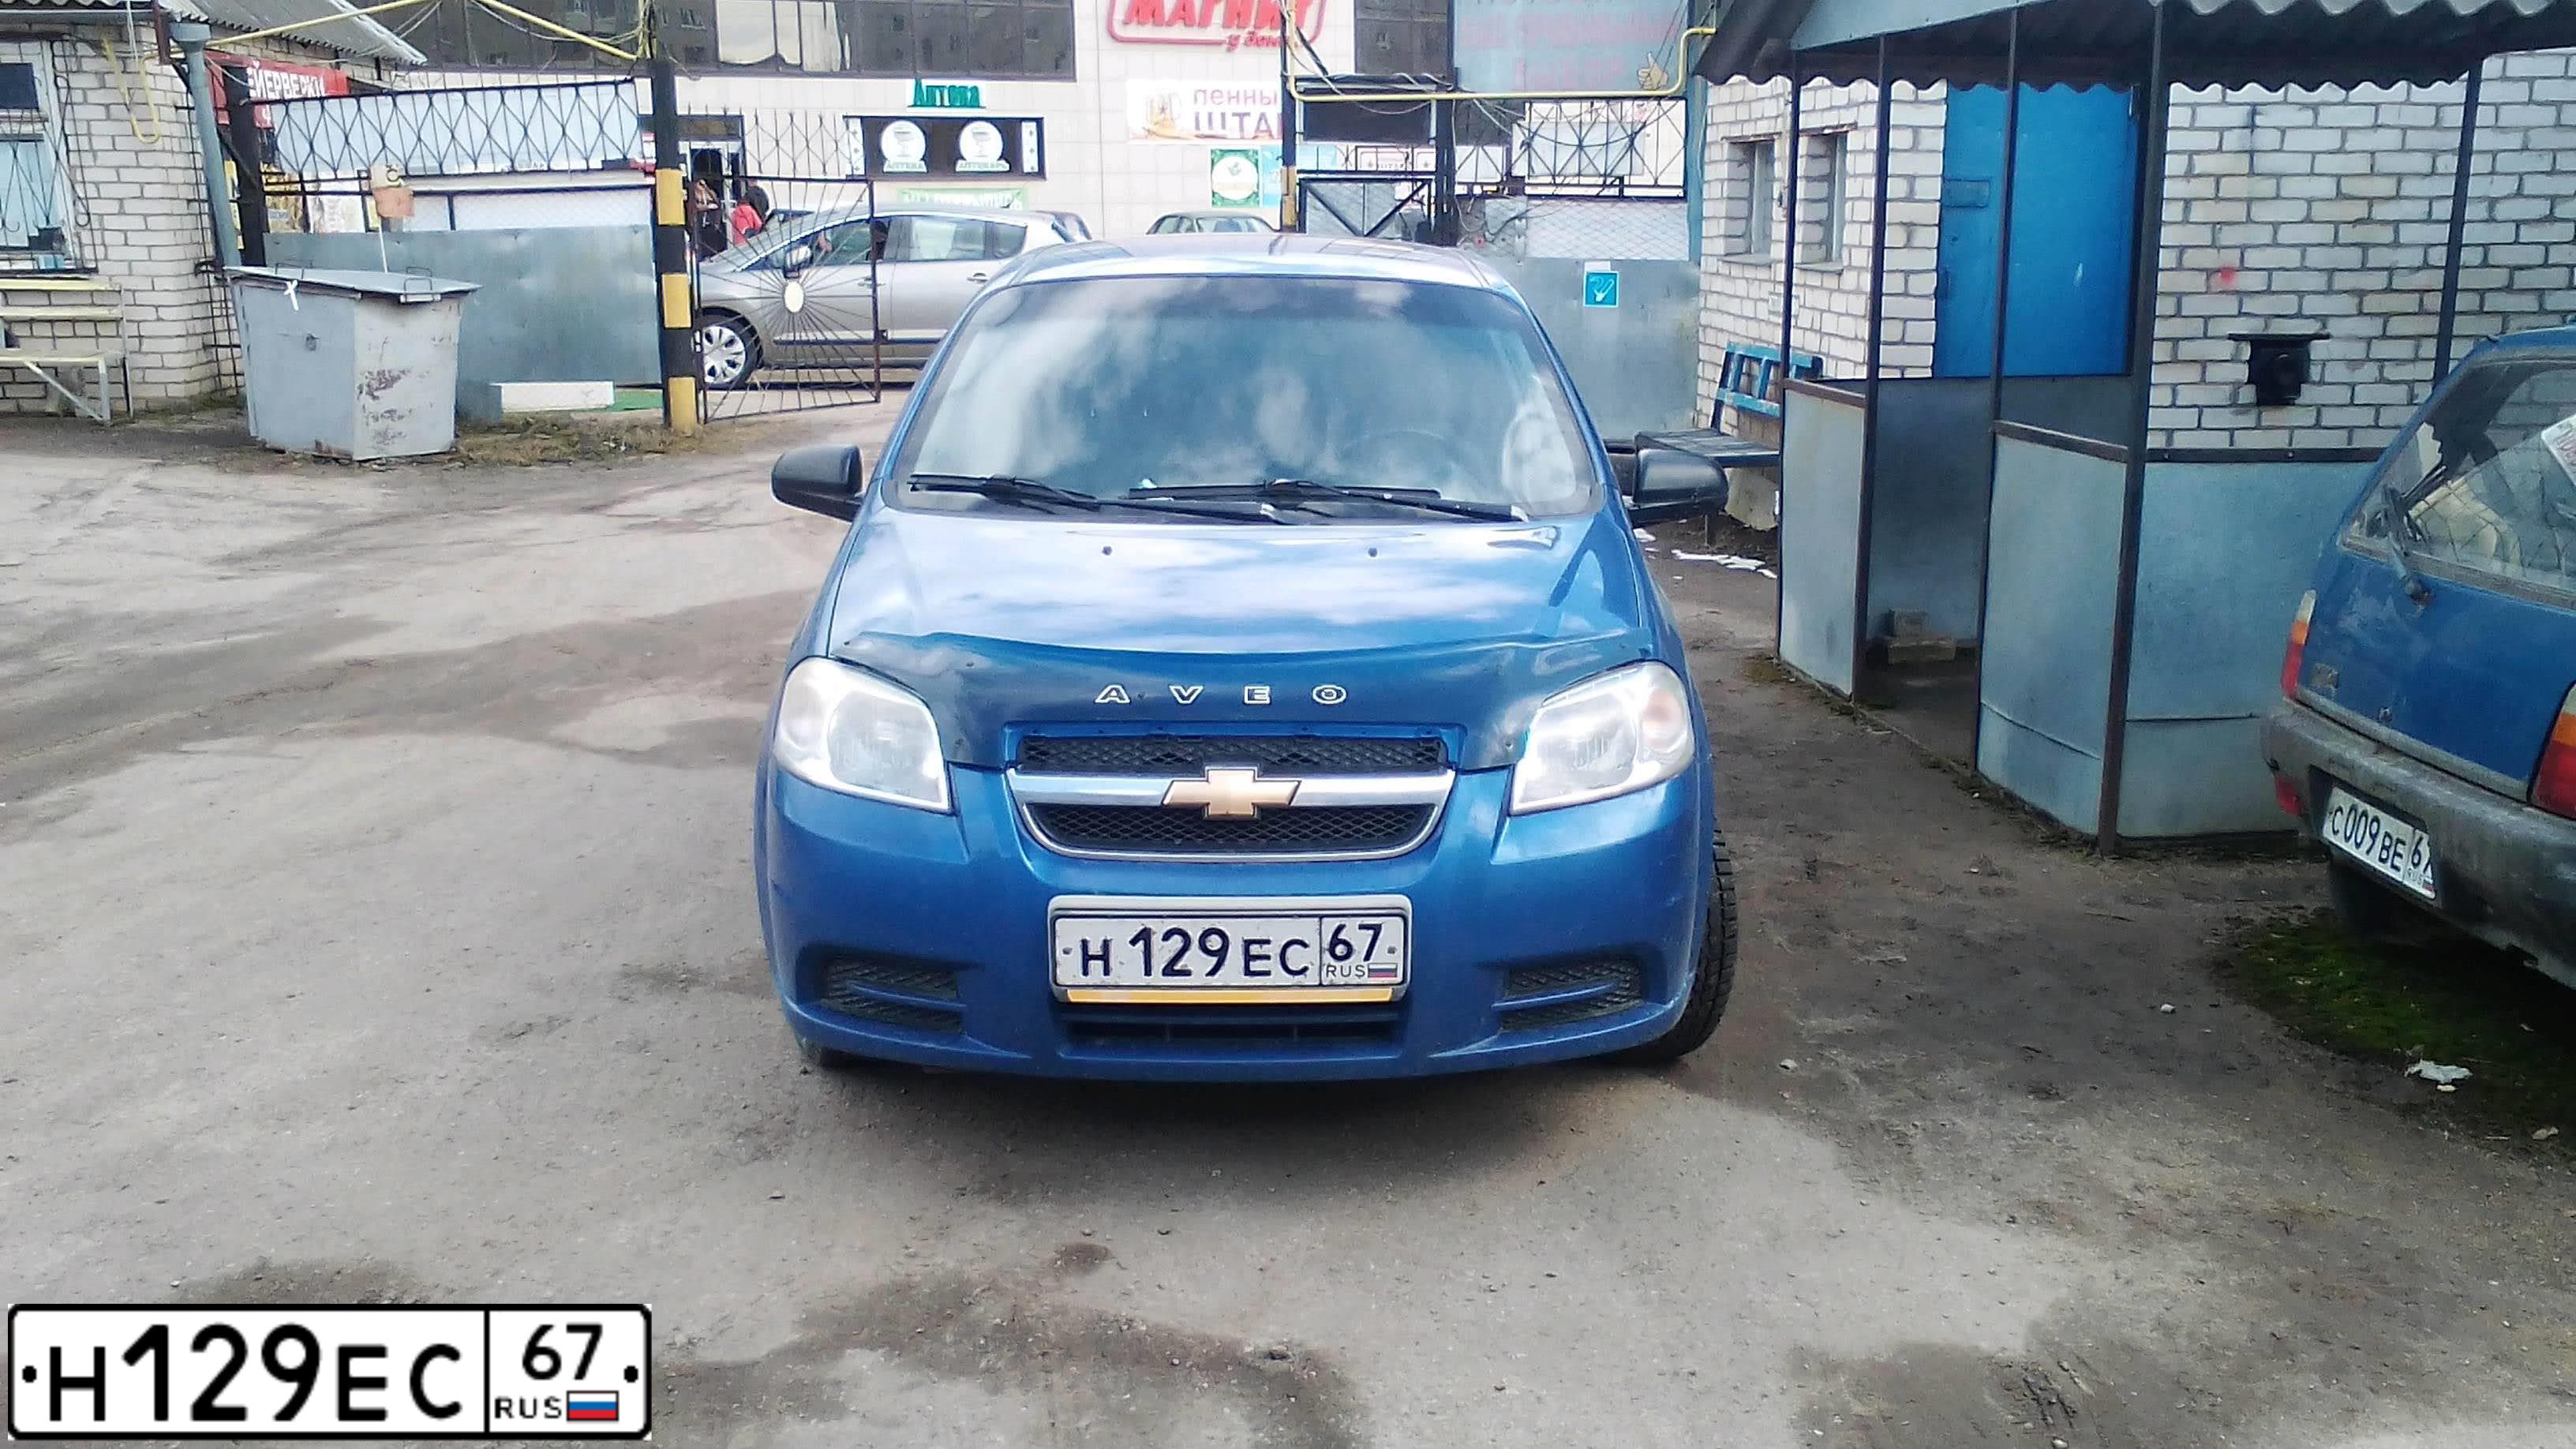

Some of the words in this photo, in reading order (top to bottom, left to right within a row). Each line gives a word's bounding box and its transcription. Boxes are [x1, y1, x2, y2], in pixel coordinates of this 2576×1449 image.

[246, 60, 326, 99] ЕЙЕРВЕРКИ
[1193, 88, 1278, 106] пенны
[1194, 112, 1283, 139] ШТА
[1095, 684, 1346, 704] AVEO
[1327, 923, 1383, 963] 67
[1325, 964, 1366, 978] RUS
